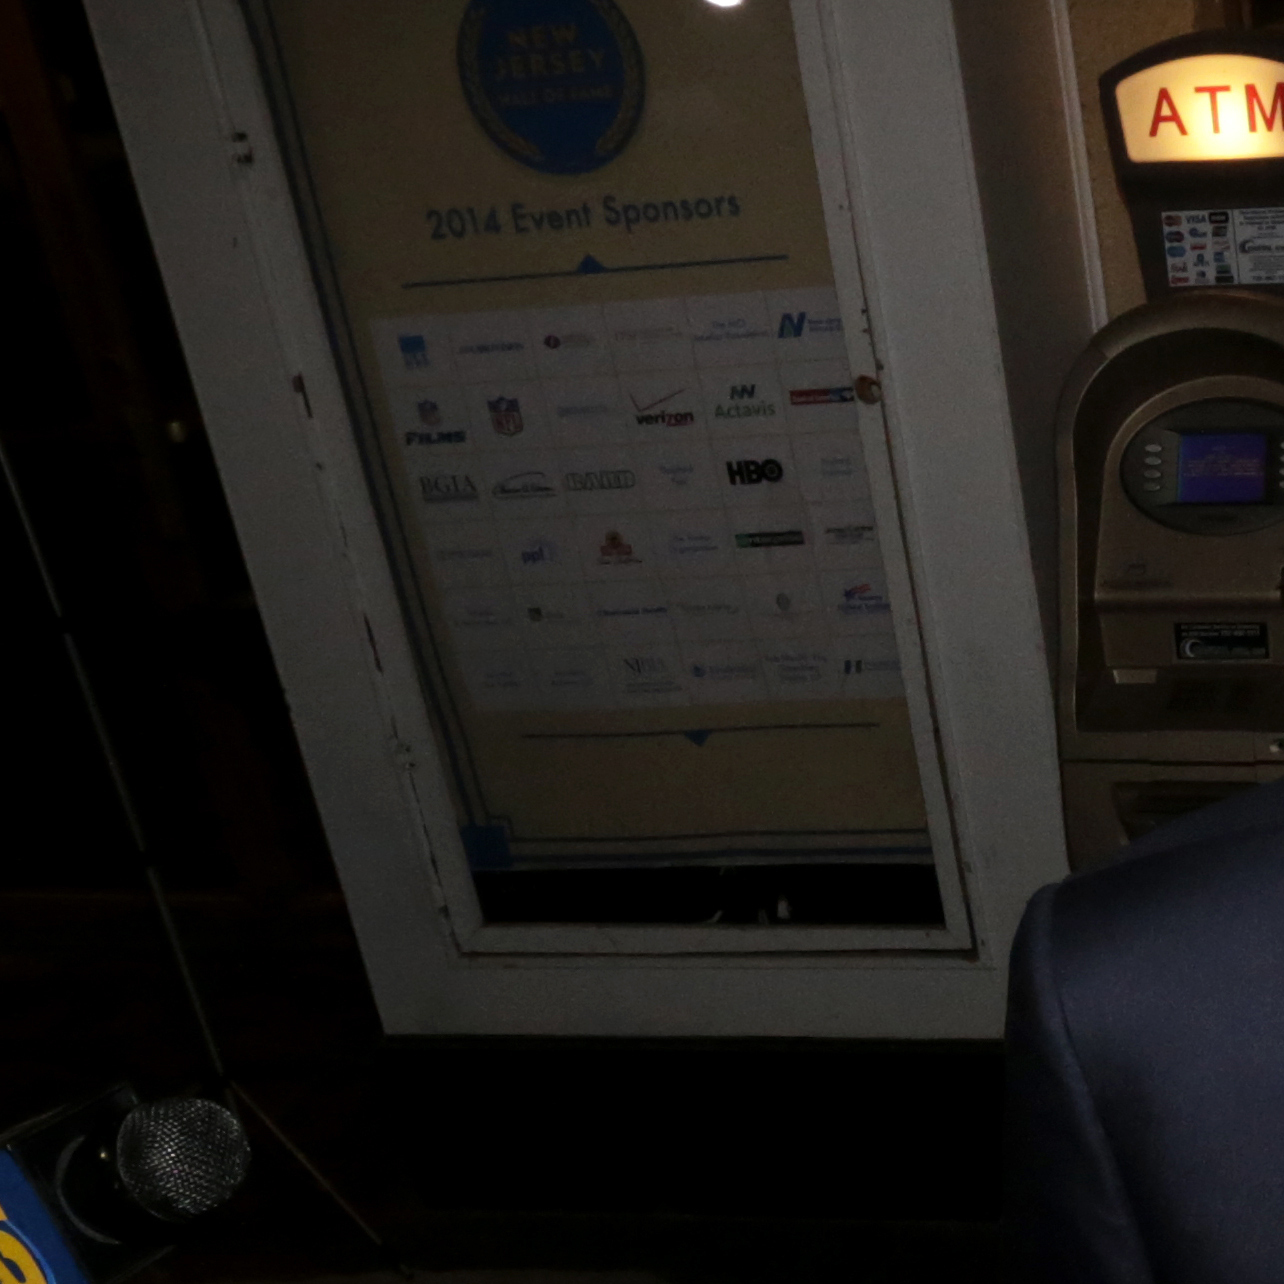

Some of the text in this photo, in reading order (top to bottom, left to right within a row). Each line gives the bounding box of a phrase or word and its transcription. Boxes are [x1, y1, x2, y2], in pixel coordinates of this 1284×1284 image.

[507, 24, 578, 48] NEW
[495, 49, 605, 80] JERSEY
[428, 195, 741, 241] 2014 Event Sponsors
[636, 409, 694, 428] verizon
[714, 398, 776, 419] Actavis
[406, 430, 467, 447] FILMS
[726, 459, 784, 485] HBO
